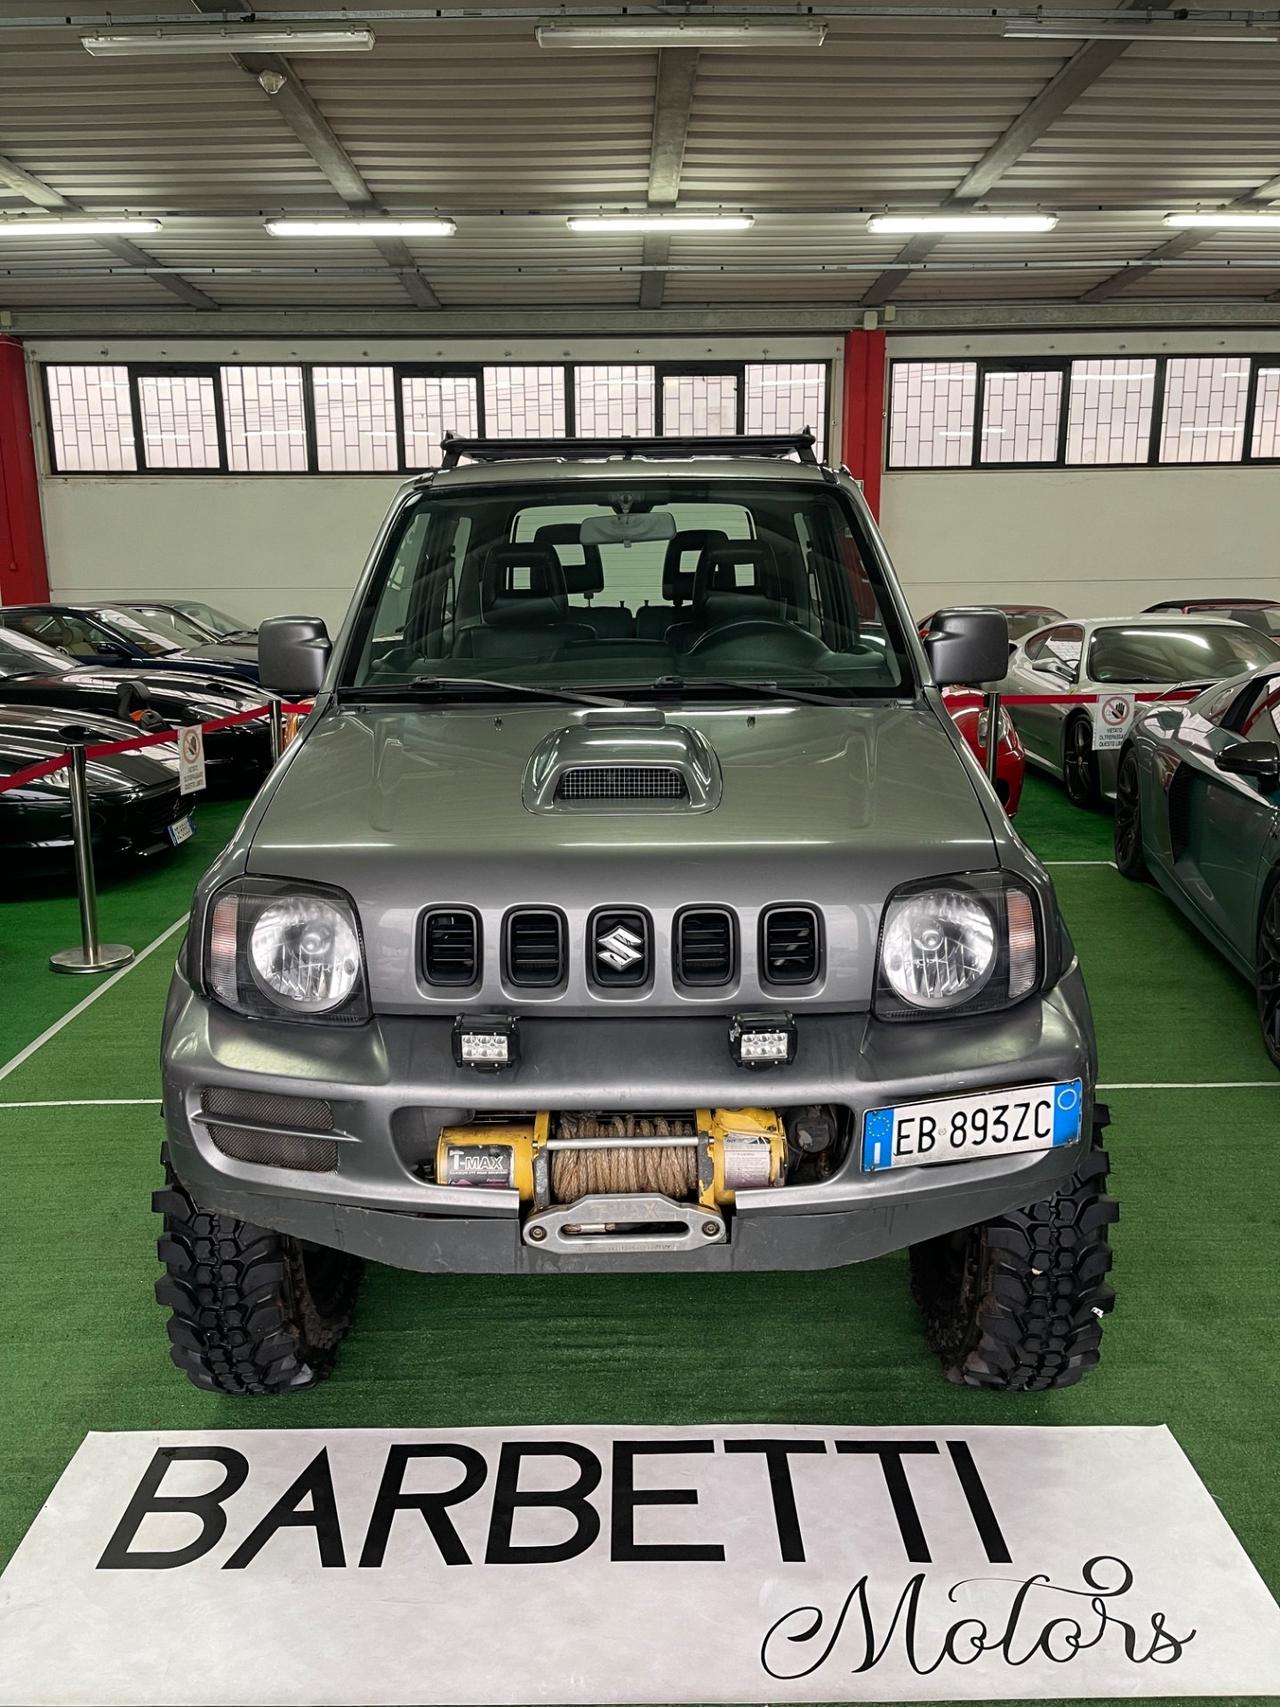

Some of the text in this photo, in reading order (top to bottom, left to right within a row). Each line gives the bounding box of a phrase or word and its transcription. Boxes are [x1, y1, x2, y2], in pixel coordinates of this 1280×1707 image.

[449, 1150, 504, 1170] T-MAX
[893, 1100, 1051, 1156] EB 893ZC
[96, 1440, 1014, 1570] BARBETTI
[761, 1556, 1197, 1680] Motors
